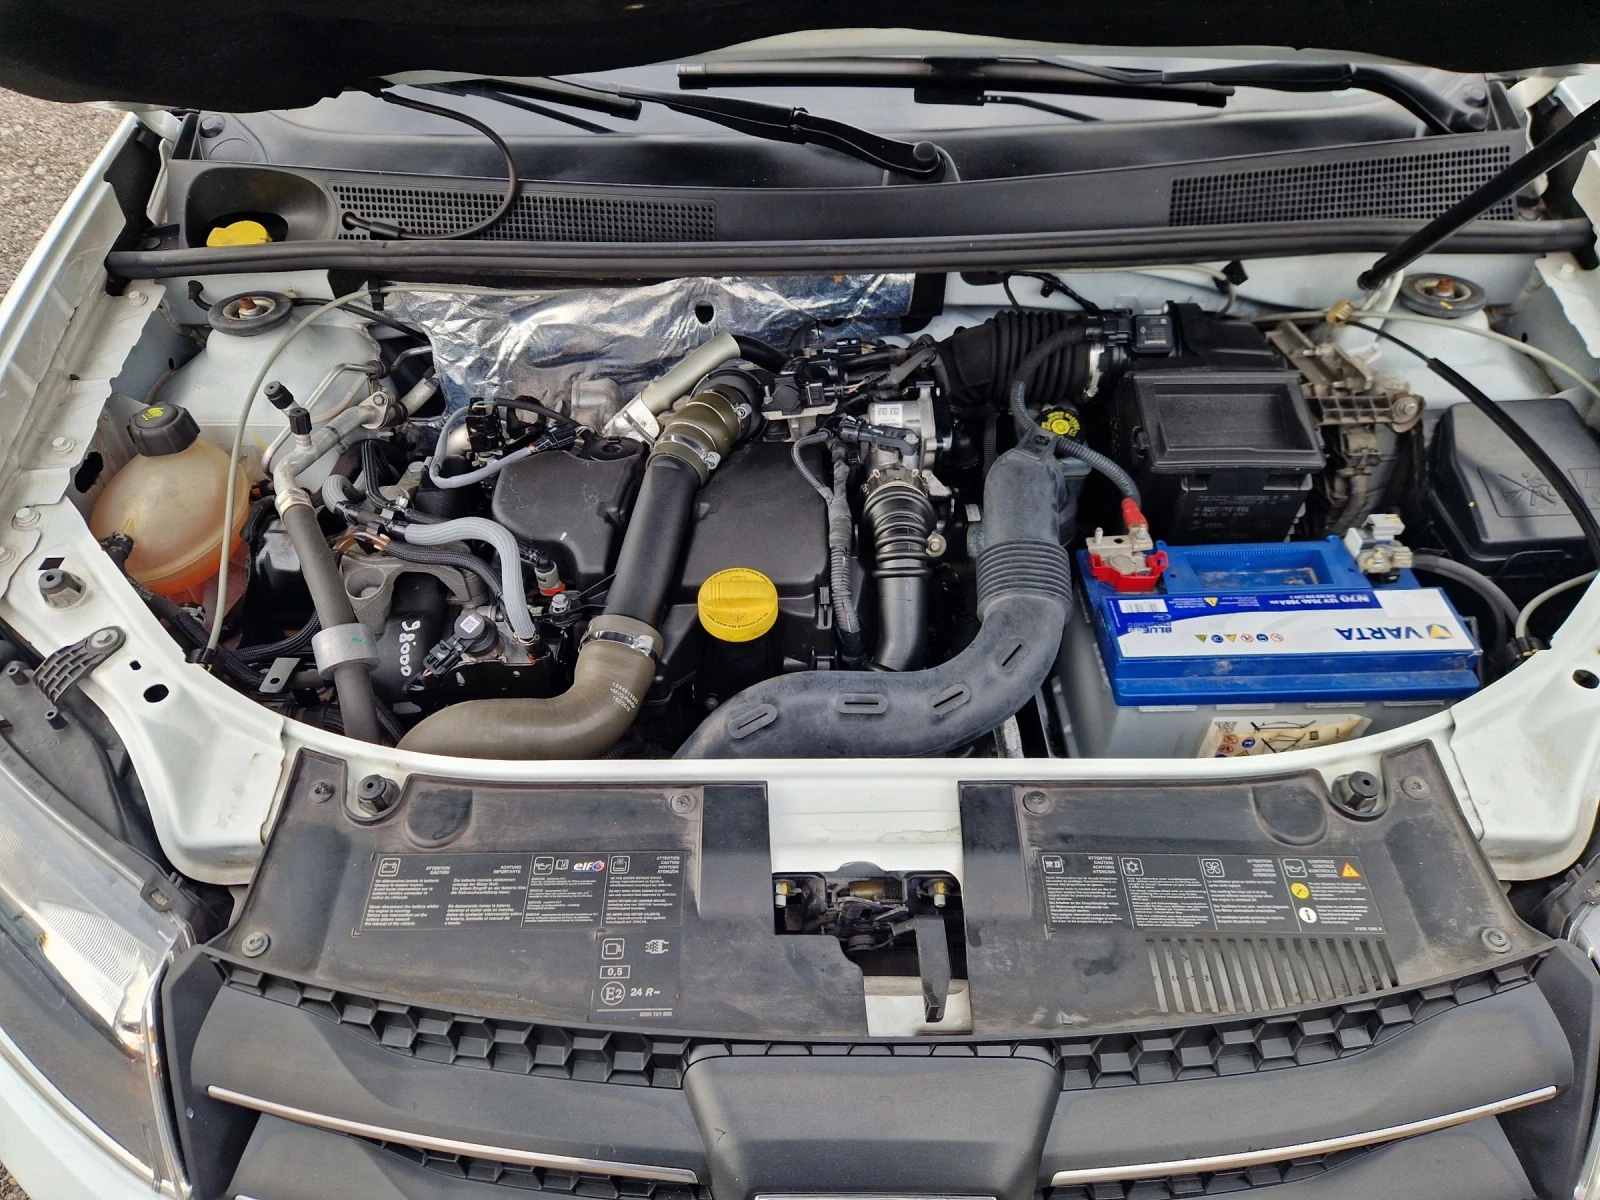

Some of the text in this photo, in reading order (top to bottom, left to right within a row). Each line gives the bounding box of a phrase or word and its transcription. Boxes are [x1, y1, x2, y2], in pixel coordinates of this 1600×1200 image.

[1340, 594, 1370, 603] N70
[1334, 626, 1424, 641] VARTA
[573, 862, 593, 871] elf
[607, 968, 622, 976] 0,5
[605, 987, 622, 1001] E2
[630, 988, 642, 997] 24
